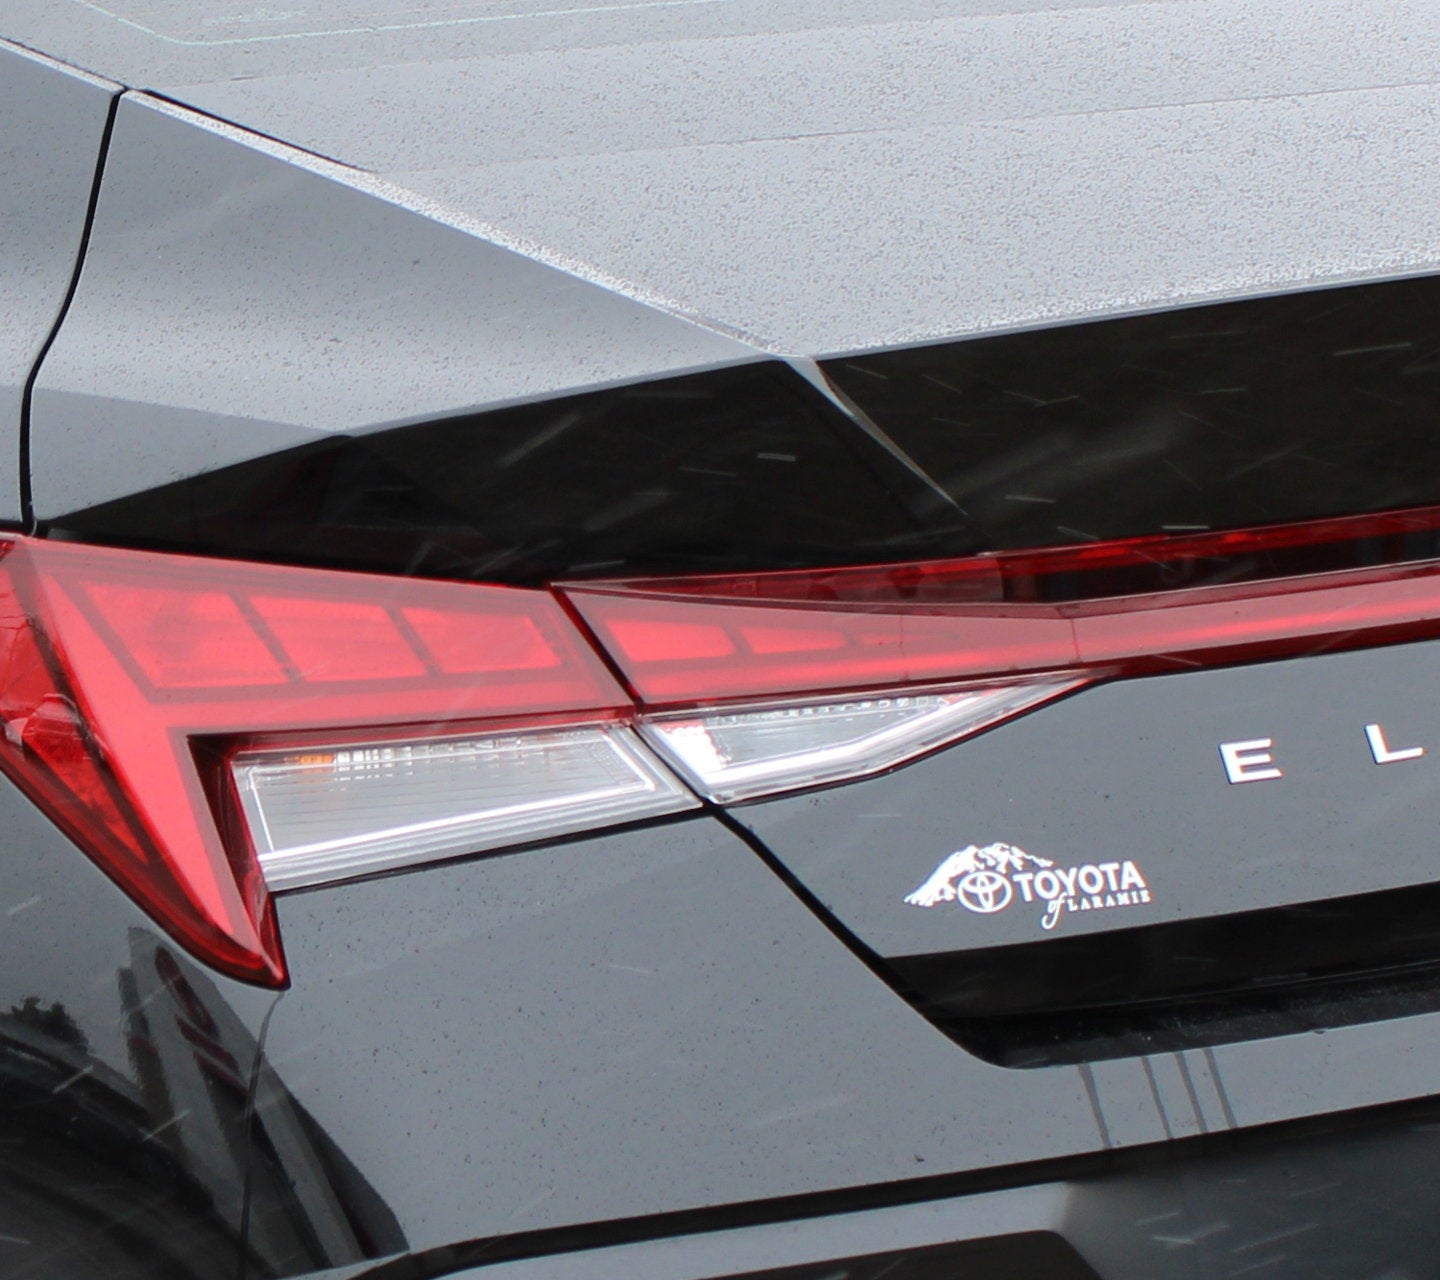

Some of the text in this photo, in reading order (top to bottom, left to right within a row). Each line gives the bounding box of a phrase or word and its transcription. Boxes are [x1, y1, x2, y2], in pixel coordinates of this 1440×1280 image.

[1012, 860, 1146, 902] TOYOTA
[1040, 889, 1152, 930] of LARAMIE
